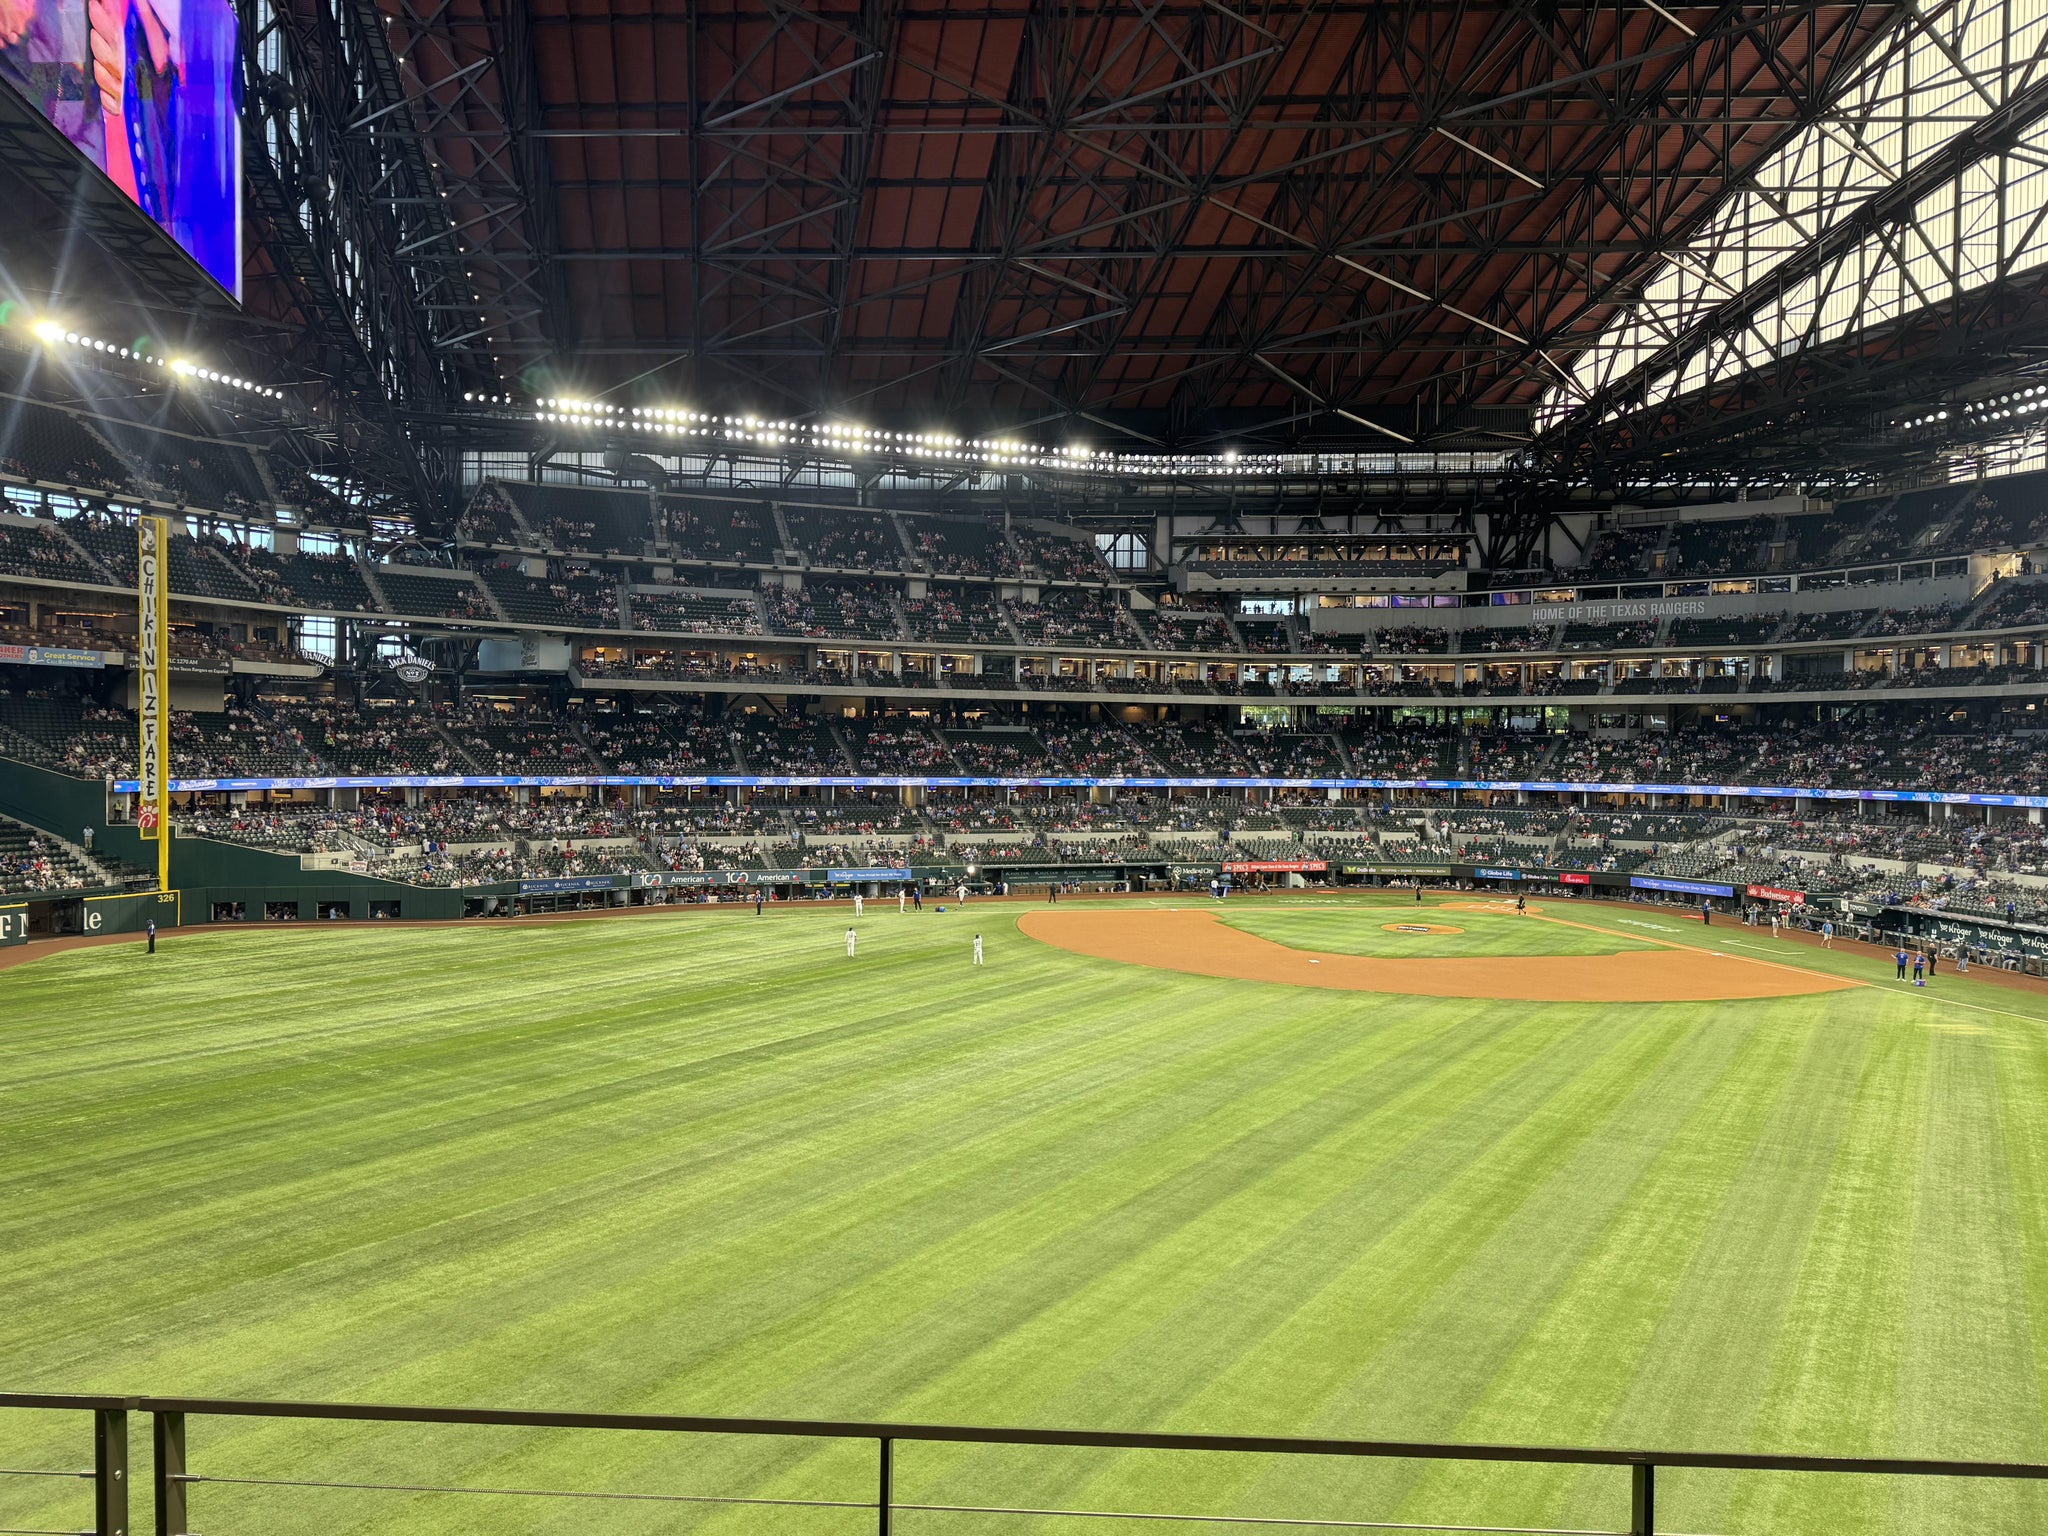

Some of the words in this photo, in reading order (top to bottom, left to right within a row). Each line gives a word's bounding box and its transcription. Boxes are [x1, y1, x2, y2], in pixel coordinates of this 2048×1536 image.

[1532, 607, 1565, 620] HOME
[1568, 607, 1583, 619] OF
[1586, 605, 1607, 618] THE
[1610, 603, 1647, 617] TEXAS
[1650, 601, 1705, 616] RANGERS
[43, 651, 66, 660] Great
[67, 653, 96, 662] Service
[387, 655, 407, 669] JACK
[144, 723, 156, 797] FARE
[757, 873, 790, 881] American
[1182, 867, 1203, 875] Medical
[1203, 867, 1214, 876] City
[670, 875, 705, 883] American
[157, 893, 175, 903] 326
[1760, 888, 1791, 901] Budweiser
[1849, 903, 1868, 912] TOYOTA
[1948, 922, 1973, 940] Kroger
[1988, 928, 2014, 947] Kroger
